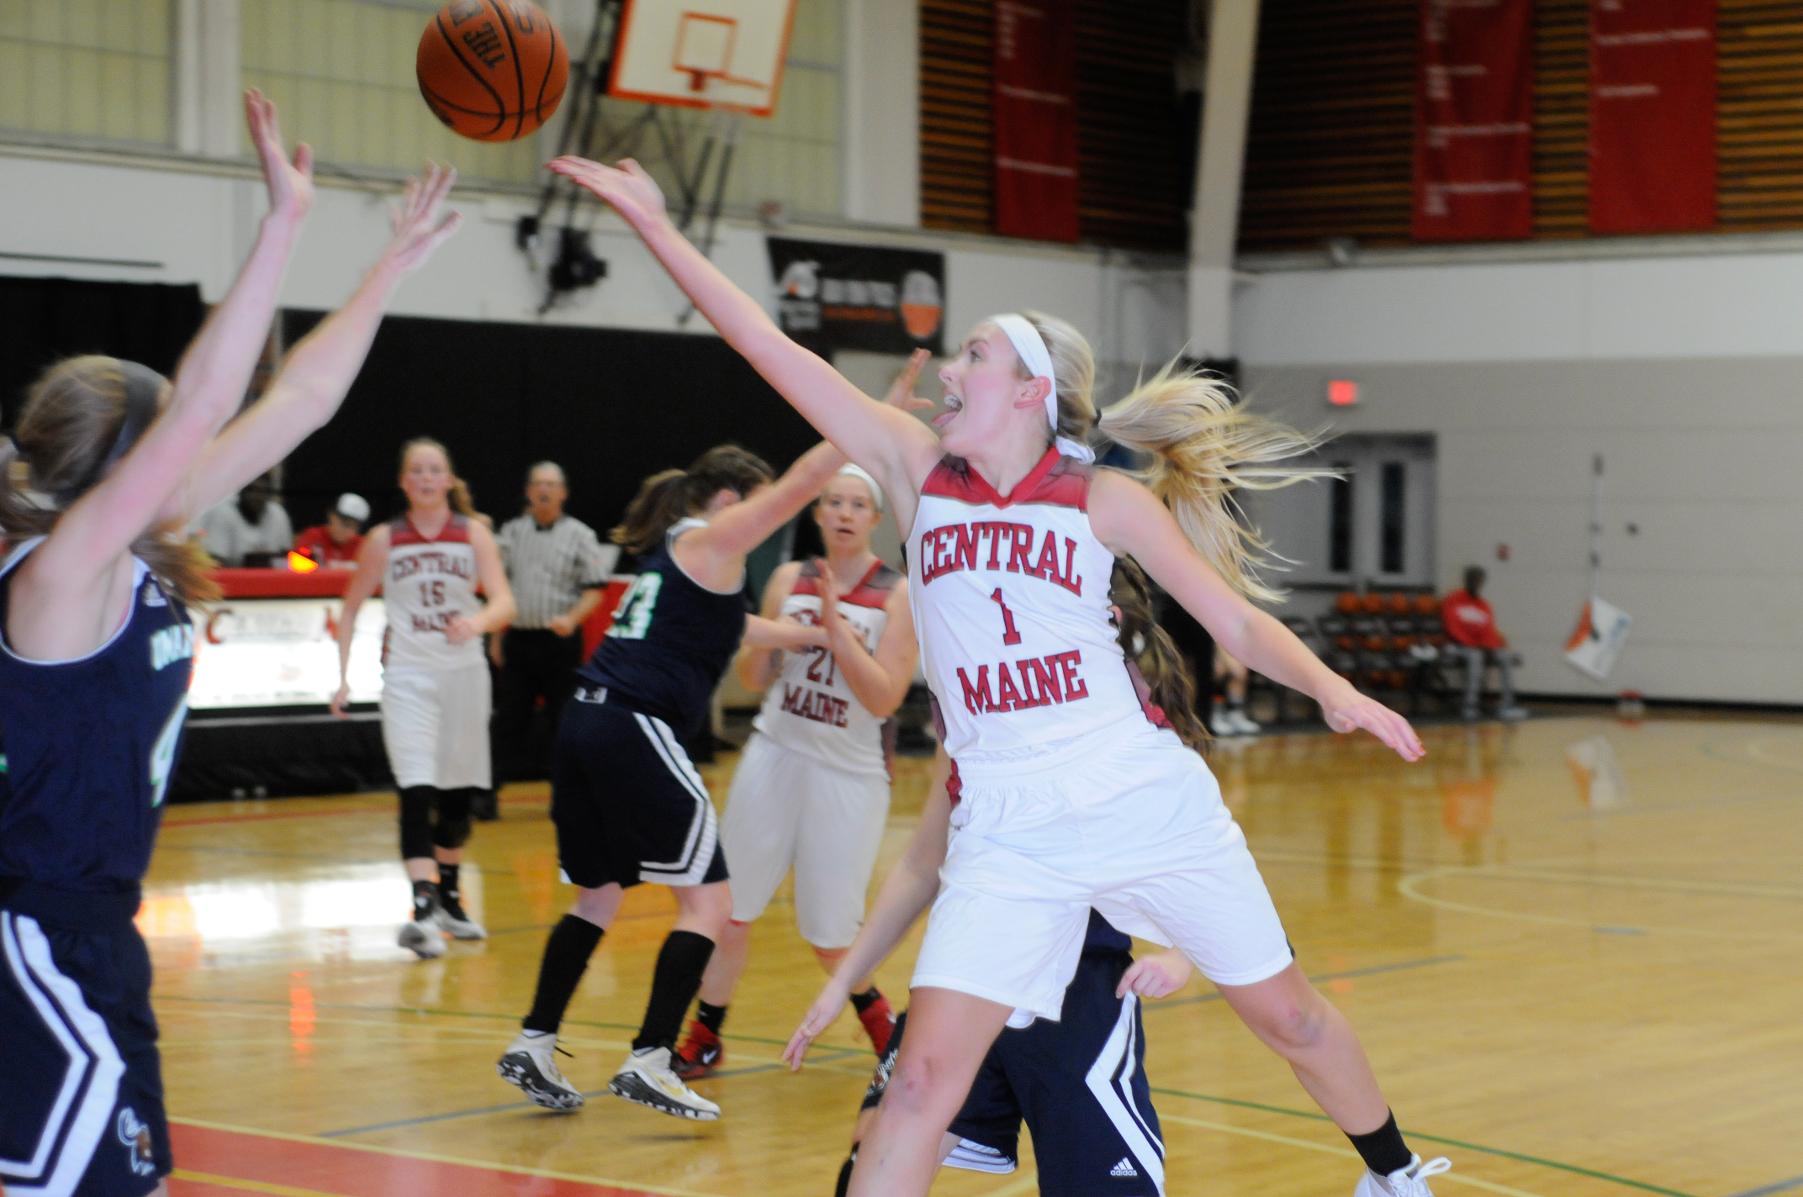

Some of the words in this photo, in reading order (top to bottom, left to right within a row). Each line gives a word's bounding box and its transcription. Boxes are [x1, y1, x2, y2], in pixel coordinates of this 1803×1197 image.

[463, 22, 505, 69] THE
[921, 521, 1082, 597] CENTRAL
[418, 580, 445, 607] 15
[990, 587, 1022, 646] 1
[805, 645, 836, 687] 21
[956, 649, 1089, 716] MAINE
[781, 681, 849, 728] MAINE
[1110, 1169, 1138, 1177] adidas
